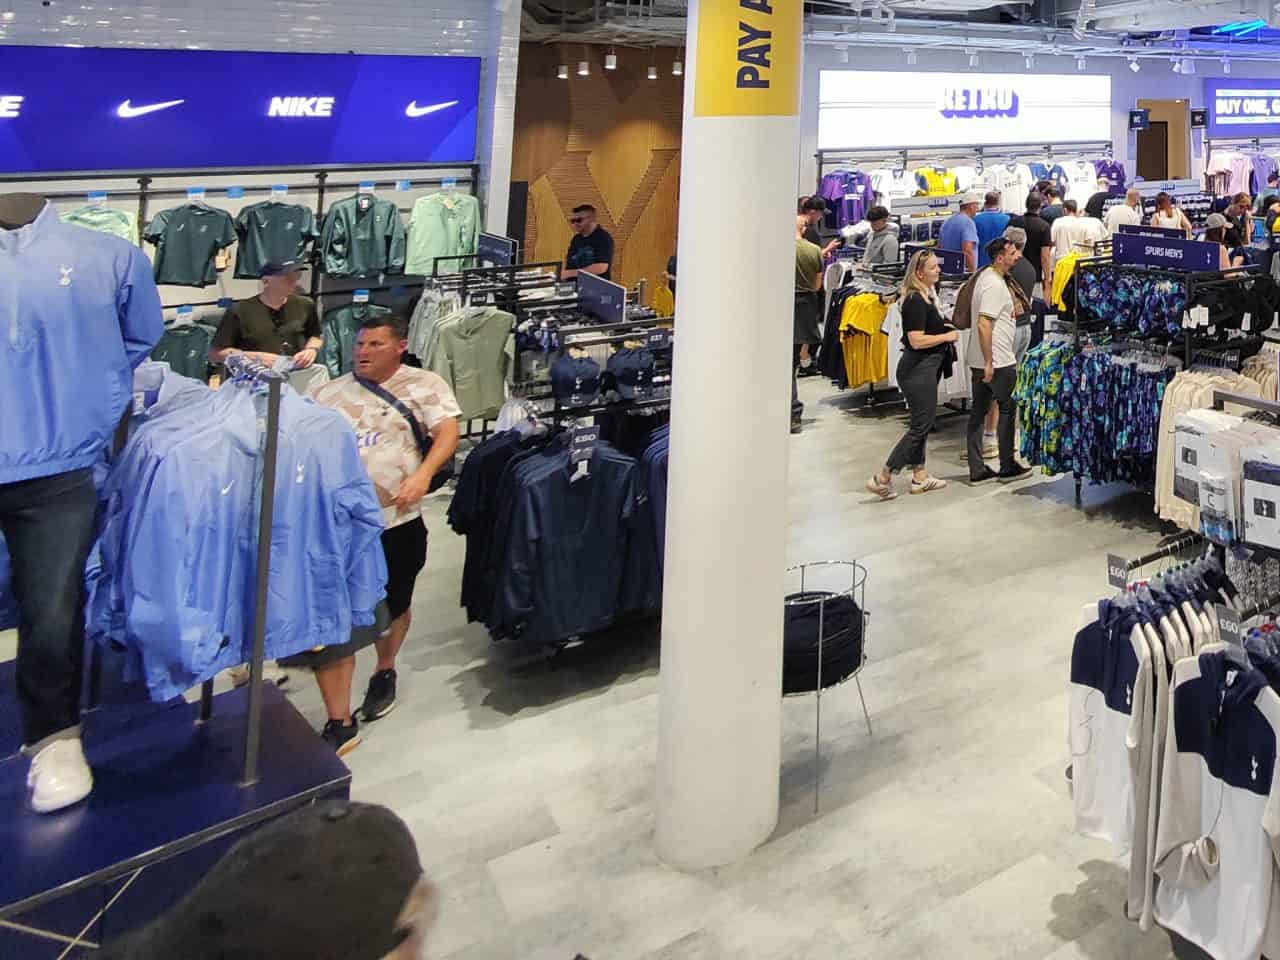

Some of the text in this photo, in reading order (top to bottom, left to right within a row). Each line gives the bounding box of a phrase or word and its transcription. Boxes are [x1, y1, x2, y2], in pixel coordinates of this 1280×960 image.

[735, 20, 772, 89] PAY
[267, 95, 336, 118] NIKE
[1215, 98, 1242, 115] BUY
[1144, 245, 1184, 260] SPURS MEN'S
